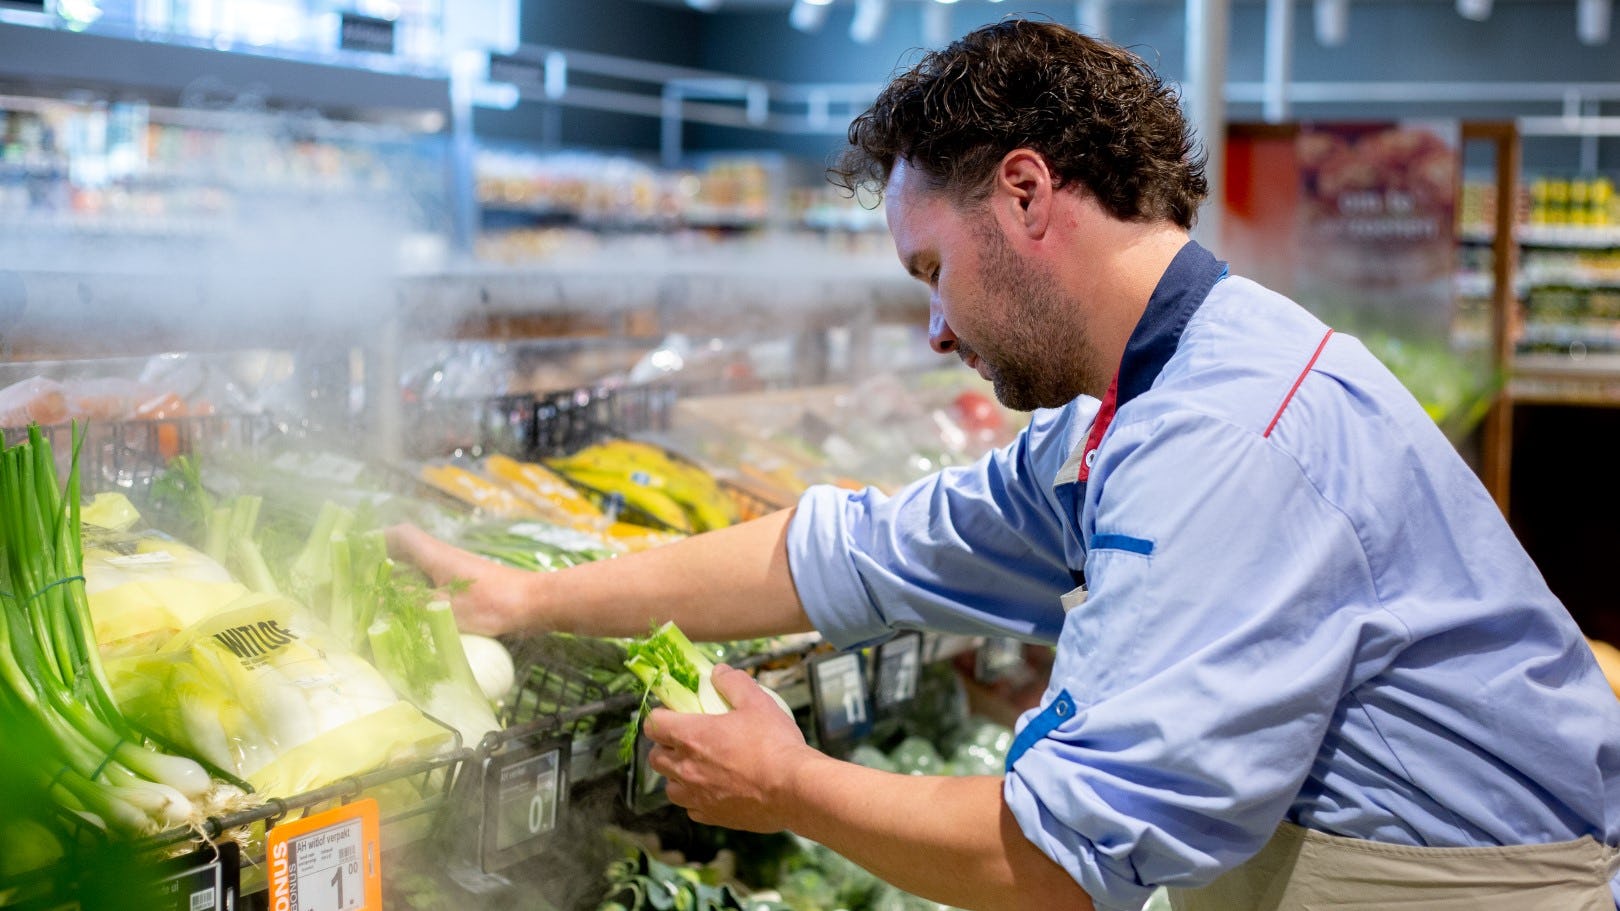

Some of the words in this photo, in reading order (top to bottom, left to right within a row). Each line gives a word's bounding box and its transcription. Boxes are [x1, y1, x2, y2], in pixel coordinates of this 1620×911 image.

[213, 620, 299, 658] WITLOF
[297, 841, 307, 852] AH
[327, 828, 350, 843] verpakt
[349, 862, 358, 874] 00
